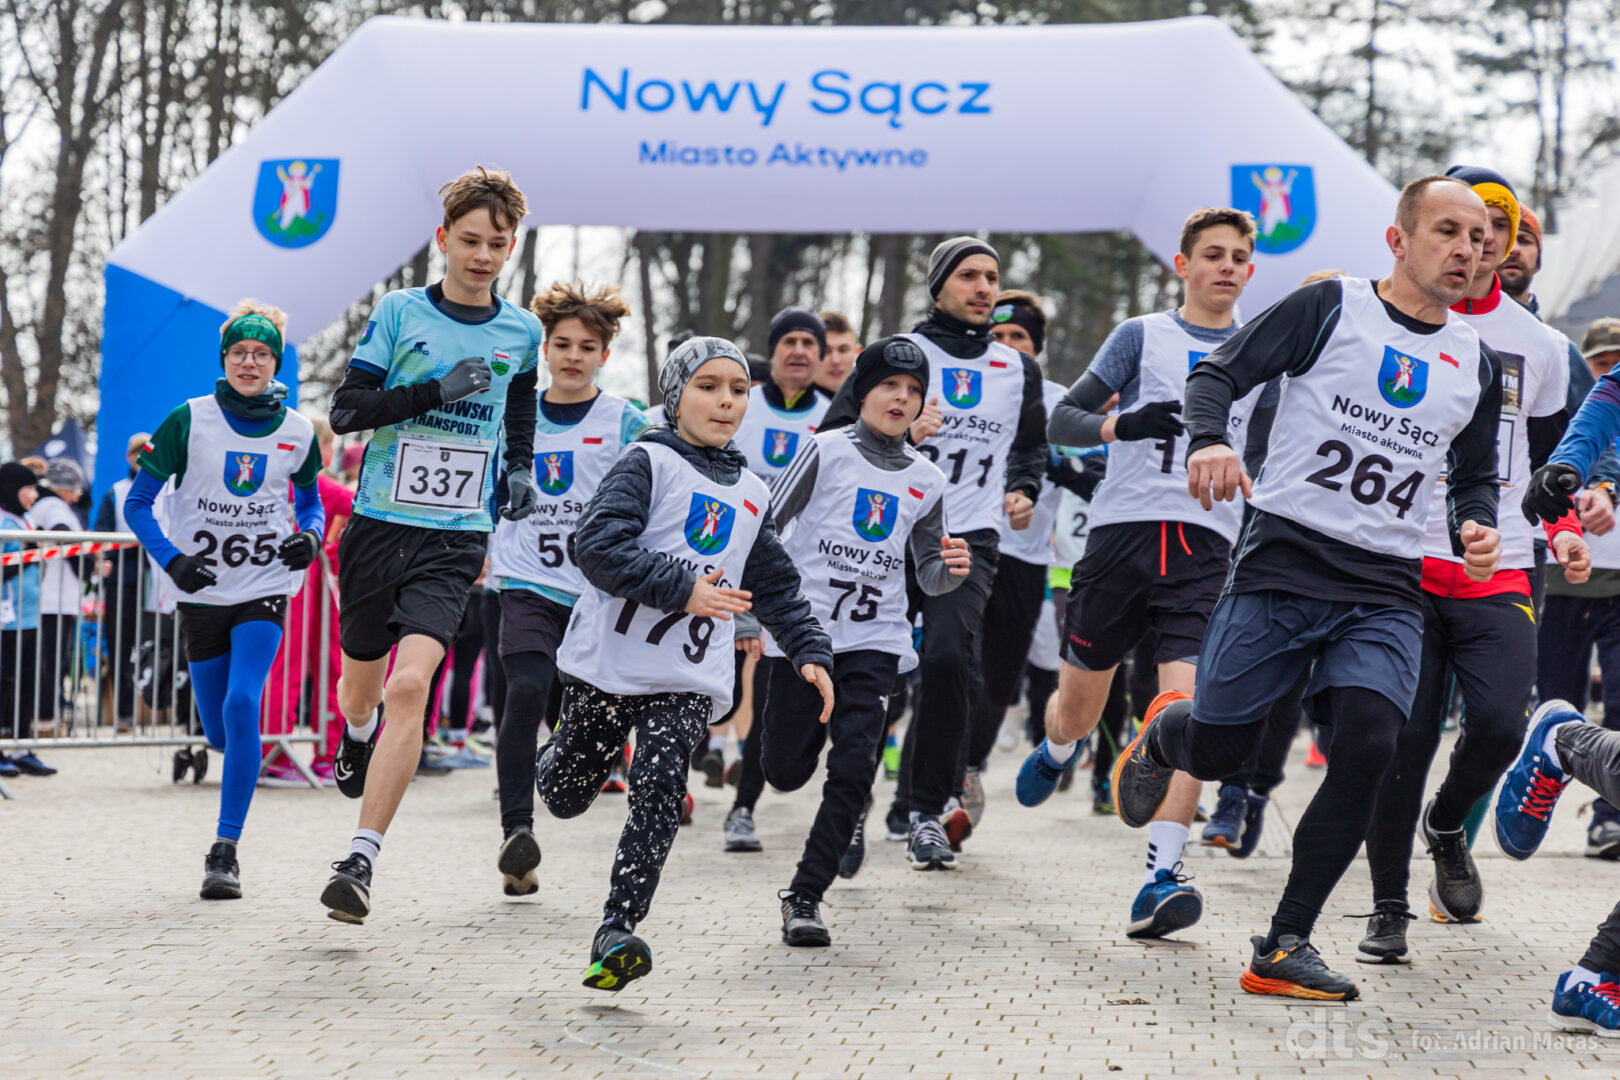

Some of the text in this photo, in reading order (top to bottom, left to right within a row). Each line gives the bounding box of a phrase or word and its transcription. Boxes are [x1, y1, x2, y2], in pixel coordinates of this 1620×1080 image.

[579, 67, 992, 129] Nowy Sącz
[638, 141, 929, 171] Miasto Aktywne
[941, 415, 1002, 434] wy Sącz
[1331, 394, 1440, 448] Nowy Sącz
[1340, 422, 1424, 460] Miasto aktywne
[409, 465, 474, 498] 337
[1304, 439, 1426, 520] 264
[198, 498, 242, 517] Nowy
[205, 517, 233, 527] Miasto
[563, 500, 586, 514] Są
[1072, 512, 1088, 537] 2
[193, 530, 277, 567] 265
[818, 538, 871, 565] Nowy
[827, 560, 859, 573] Miasto
[829, 578, 882, 622] 75
